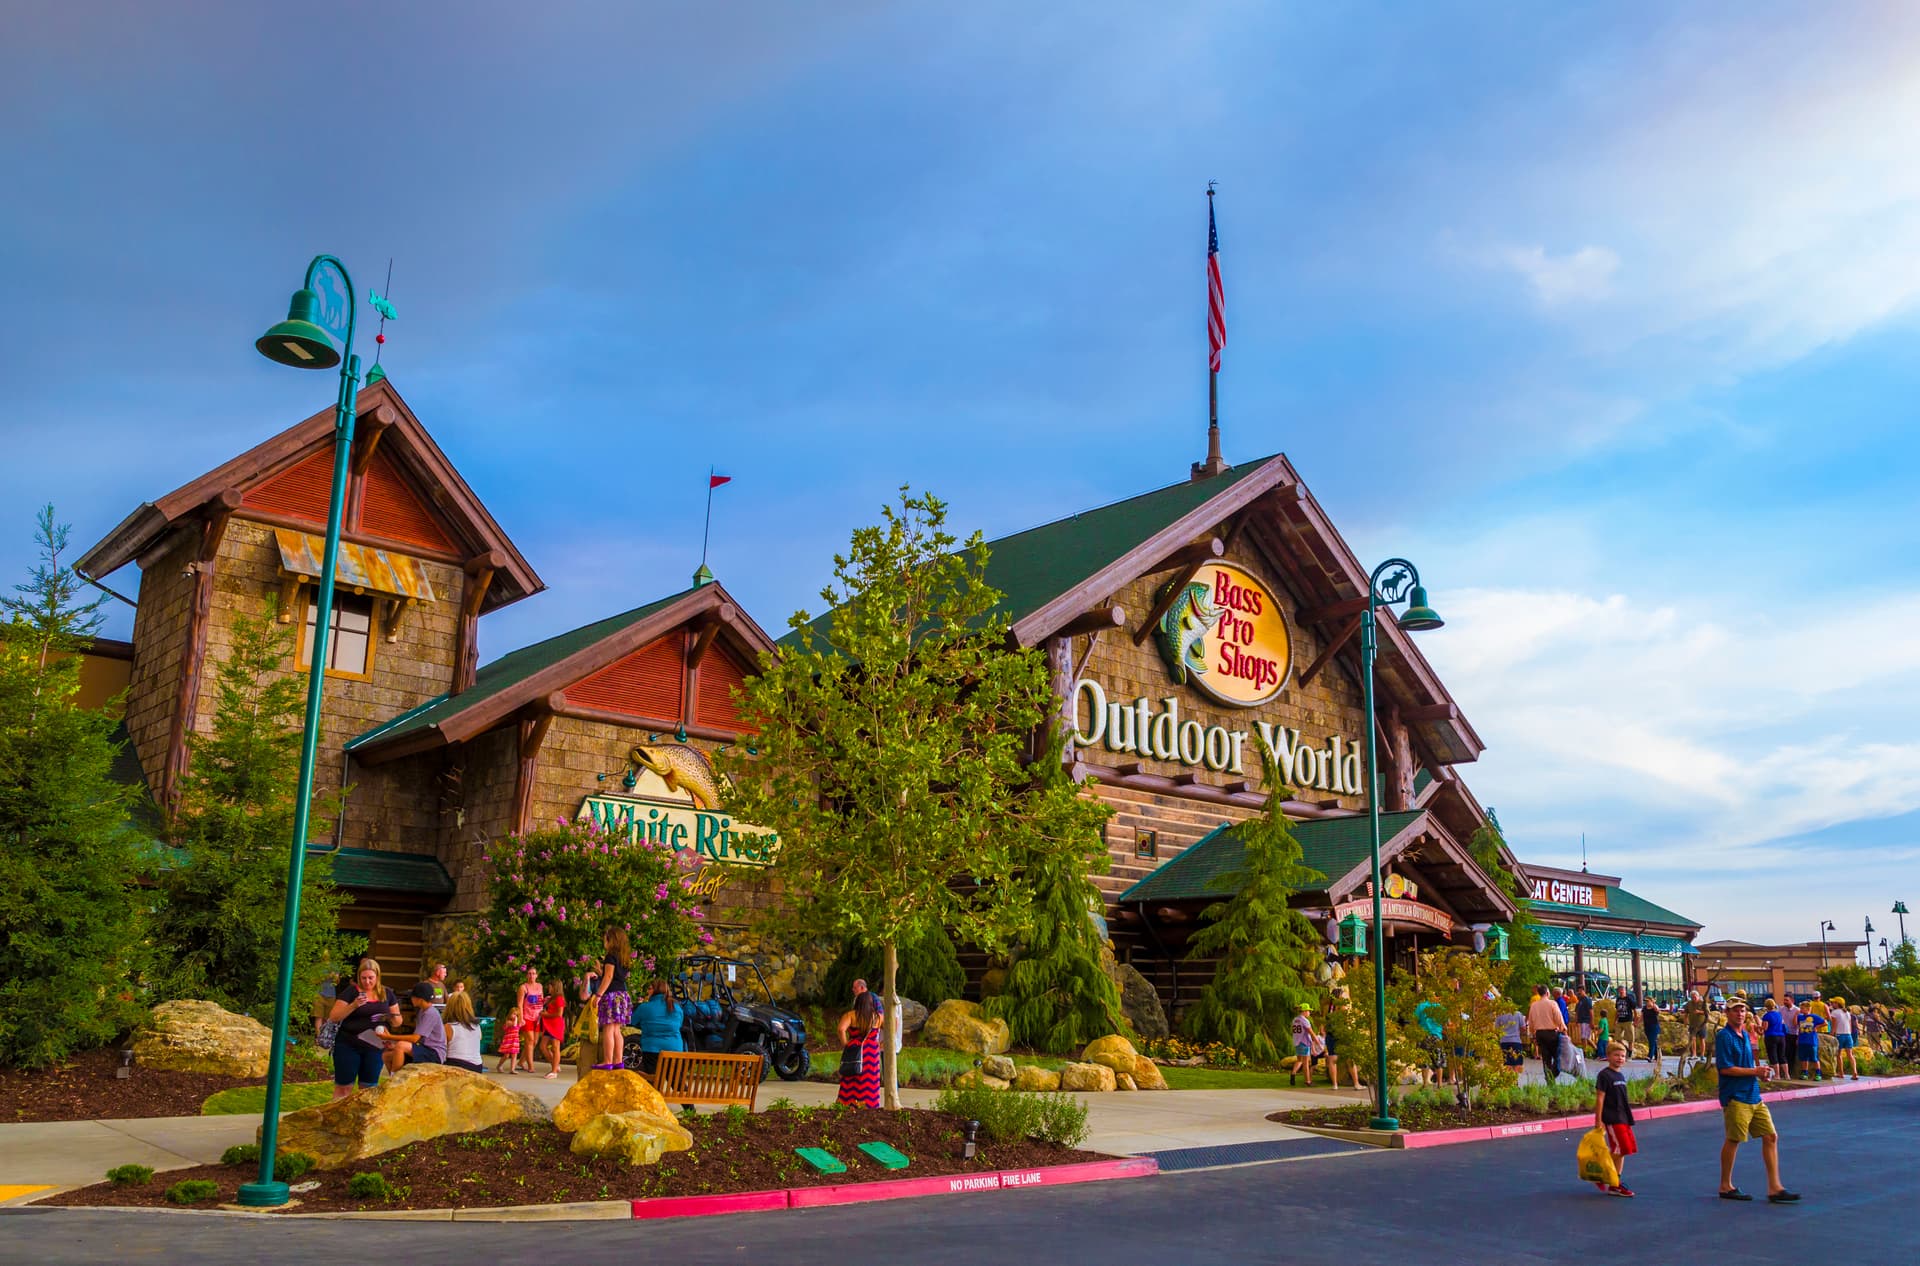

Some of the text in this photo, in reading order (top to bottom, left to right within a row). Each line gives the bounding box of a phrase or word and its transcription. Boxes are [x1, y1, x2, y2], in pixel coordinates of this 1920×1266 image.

[1213, 570, 1262, 616] Bass
[1216, 608, 1255, 646] Pro
[1217, 641, 1278, 691] Shops
[1073, 678, 1248, 775] Outdoor
[1253, 720, 1363, 796] World
[587, 800, 688, 853] White
[1551, 880, 1592, 905] CENTER
[950, 1172, 1041, 1191] NO PARKING FIRE LANE
